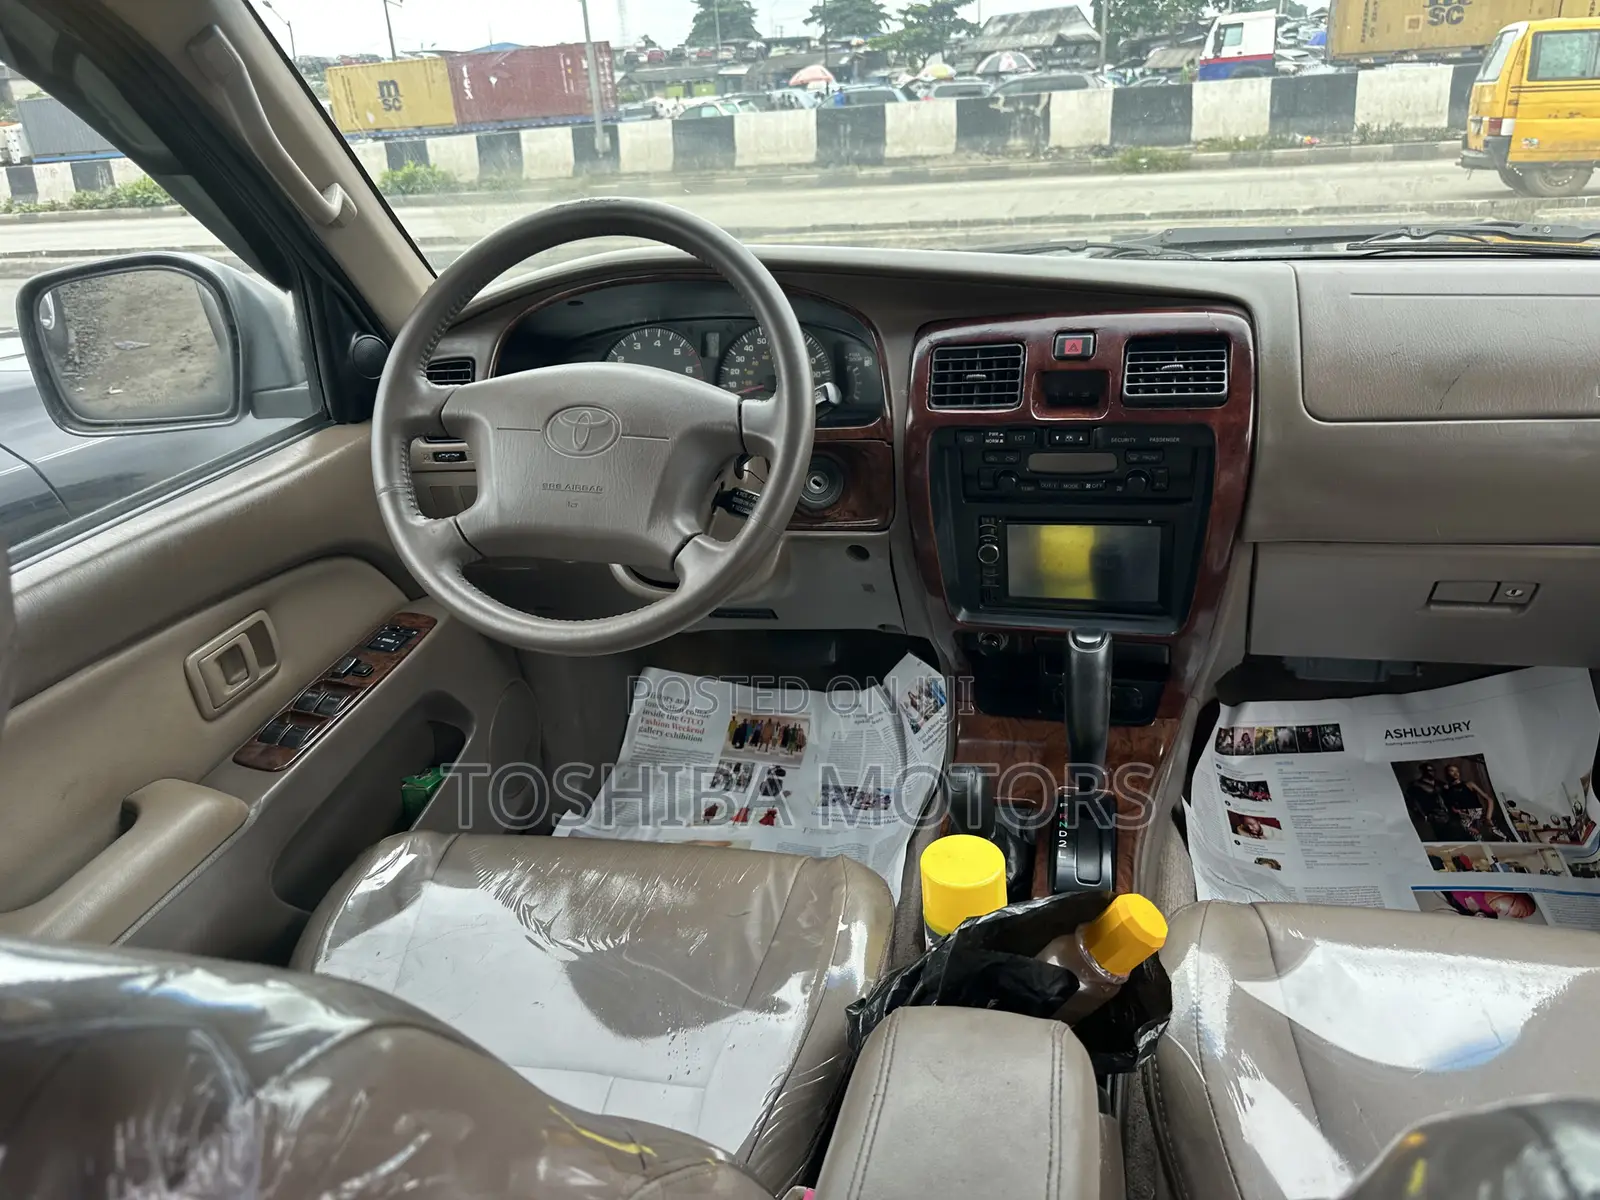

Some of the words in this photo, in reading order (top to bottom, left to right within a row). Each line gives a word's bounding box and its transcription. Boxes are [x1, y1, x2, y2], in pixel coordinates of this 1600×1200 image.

[653, 339, 662, 348] 4
[756, 337, 767, 345] 50
[633, 342, 642, 350] 3
[743, 344, 754, 352] 40
[673, 348, 681, 356] 5
[735, 355, 745, 363] 30
[685, 366, 693, 374] 6
[564, 483, 604, 492] AIRBAG
[642, 708, 666, 720] inside
[666, 711, 680, 722] the
[640, 717, 670, 729] Fashion
[671, 722, 705, 735] Weekend
[1384, 720, 1472, 740] ASHLUXURY
[638, 726, 664, 738] gallery
[664, 730, 703, 742] exhibition
[1058, 840, 1067, 848] 2
[1058, 850, 1067, 859] L
